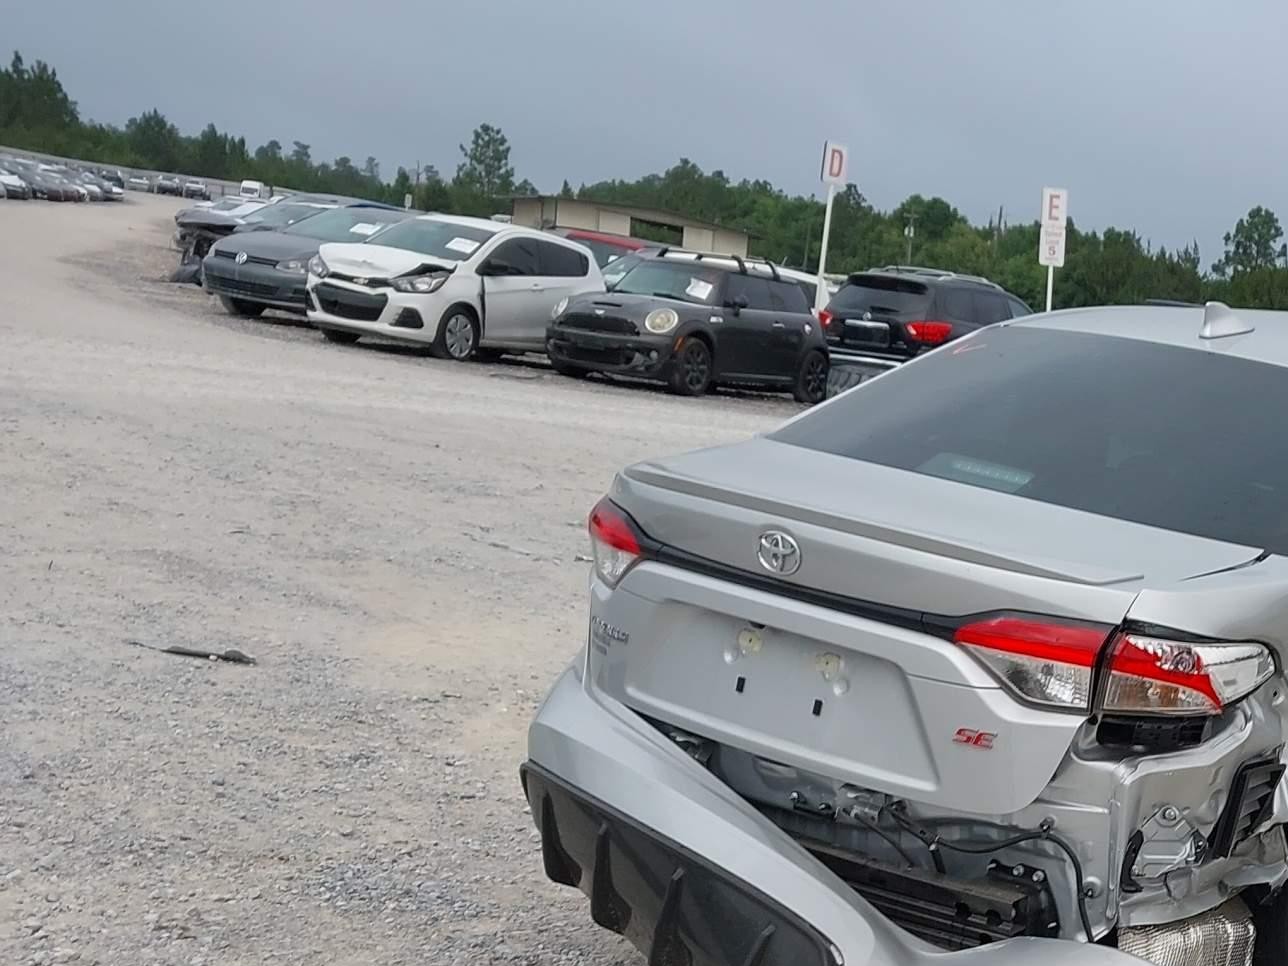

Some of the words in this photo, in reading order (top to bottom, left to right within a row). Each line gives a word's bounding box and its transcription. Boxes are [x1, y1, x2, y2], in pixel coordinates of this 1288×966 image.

[829, 148, 843, 178] D
[1049, 194, 1060, 221] E
[952, 726, 998, 750] SE
